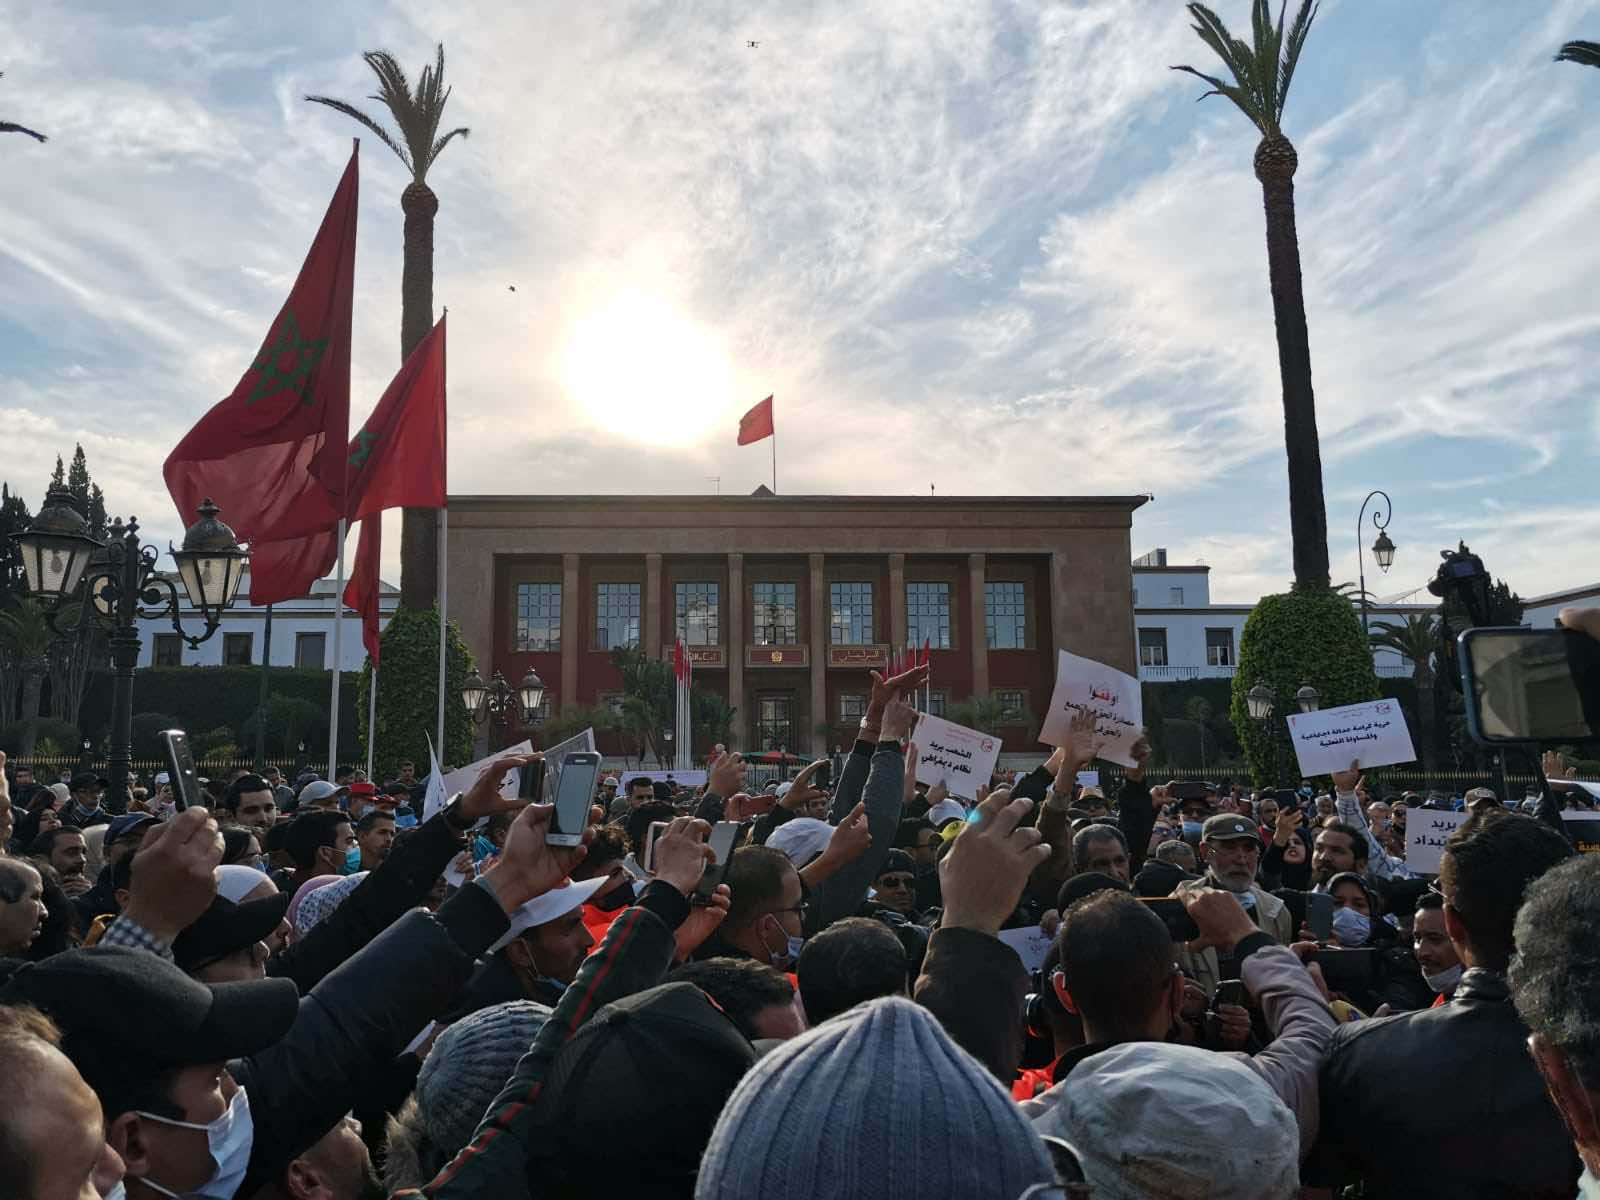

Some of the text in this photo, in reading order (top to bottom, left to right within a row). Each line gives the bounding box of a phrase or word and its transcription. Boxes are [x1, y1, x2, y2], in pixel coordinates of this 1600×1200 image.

[1301, 720, 1391, 741] حرية كرامة عدالة اجتماعية
[1320, 733, 1378, 747] والمساواة الفعلية
[929, 741, 972, 760] الشعب يريد
[953, 763, 971, 774] نظام
[1431, 819, 1457, 832] يريد
